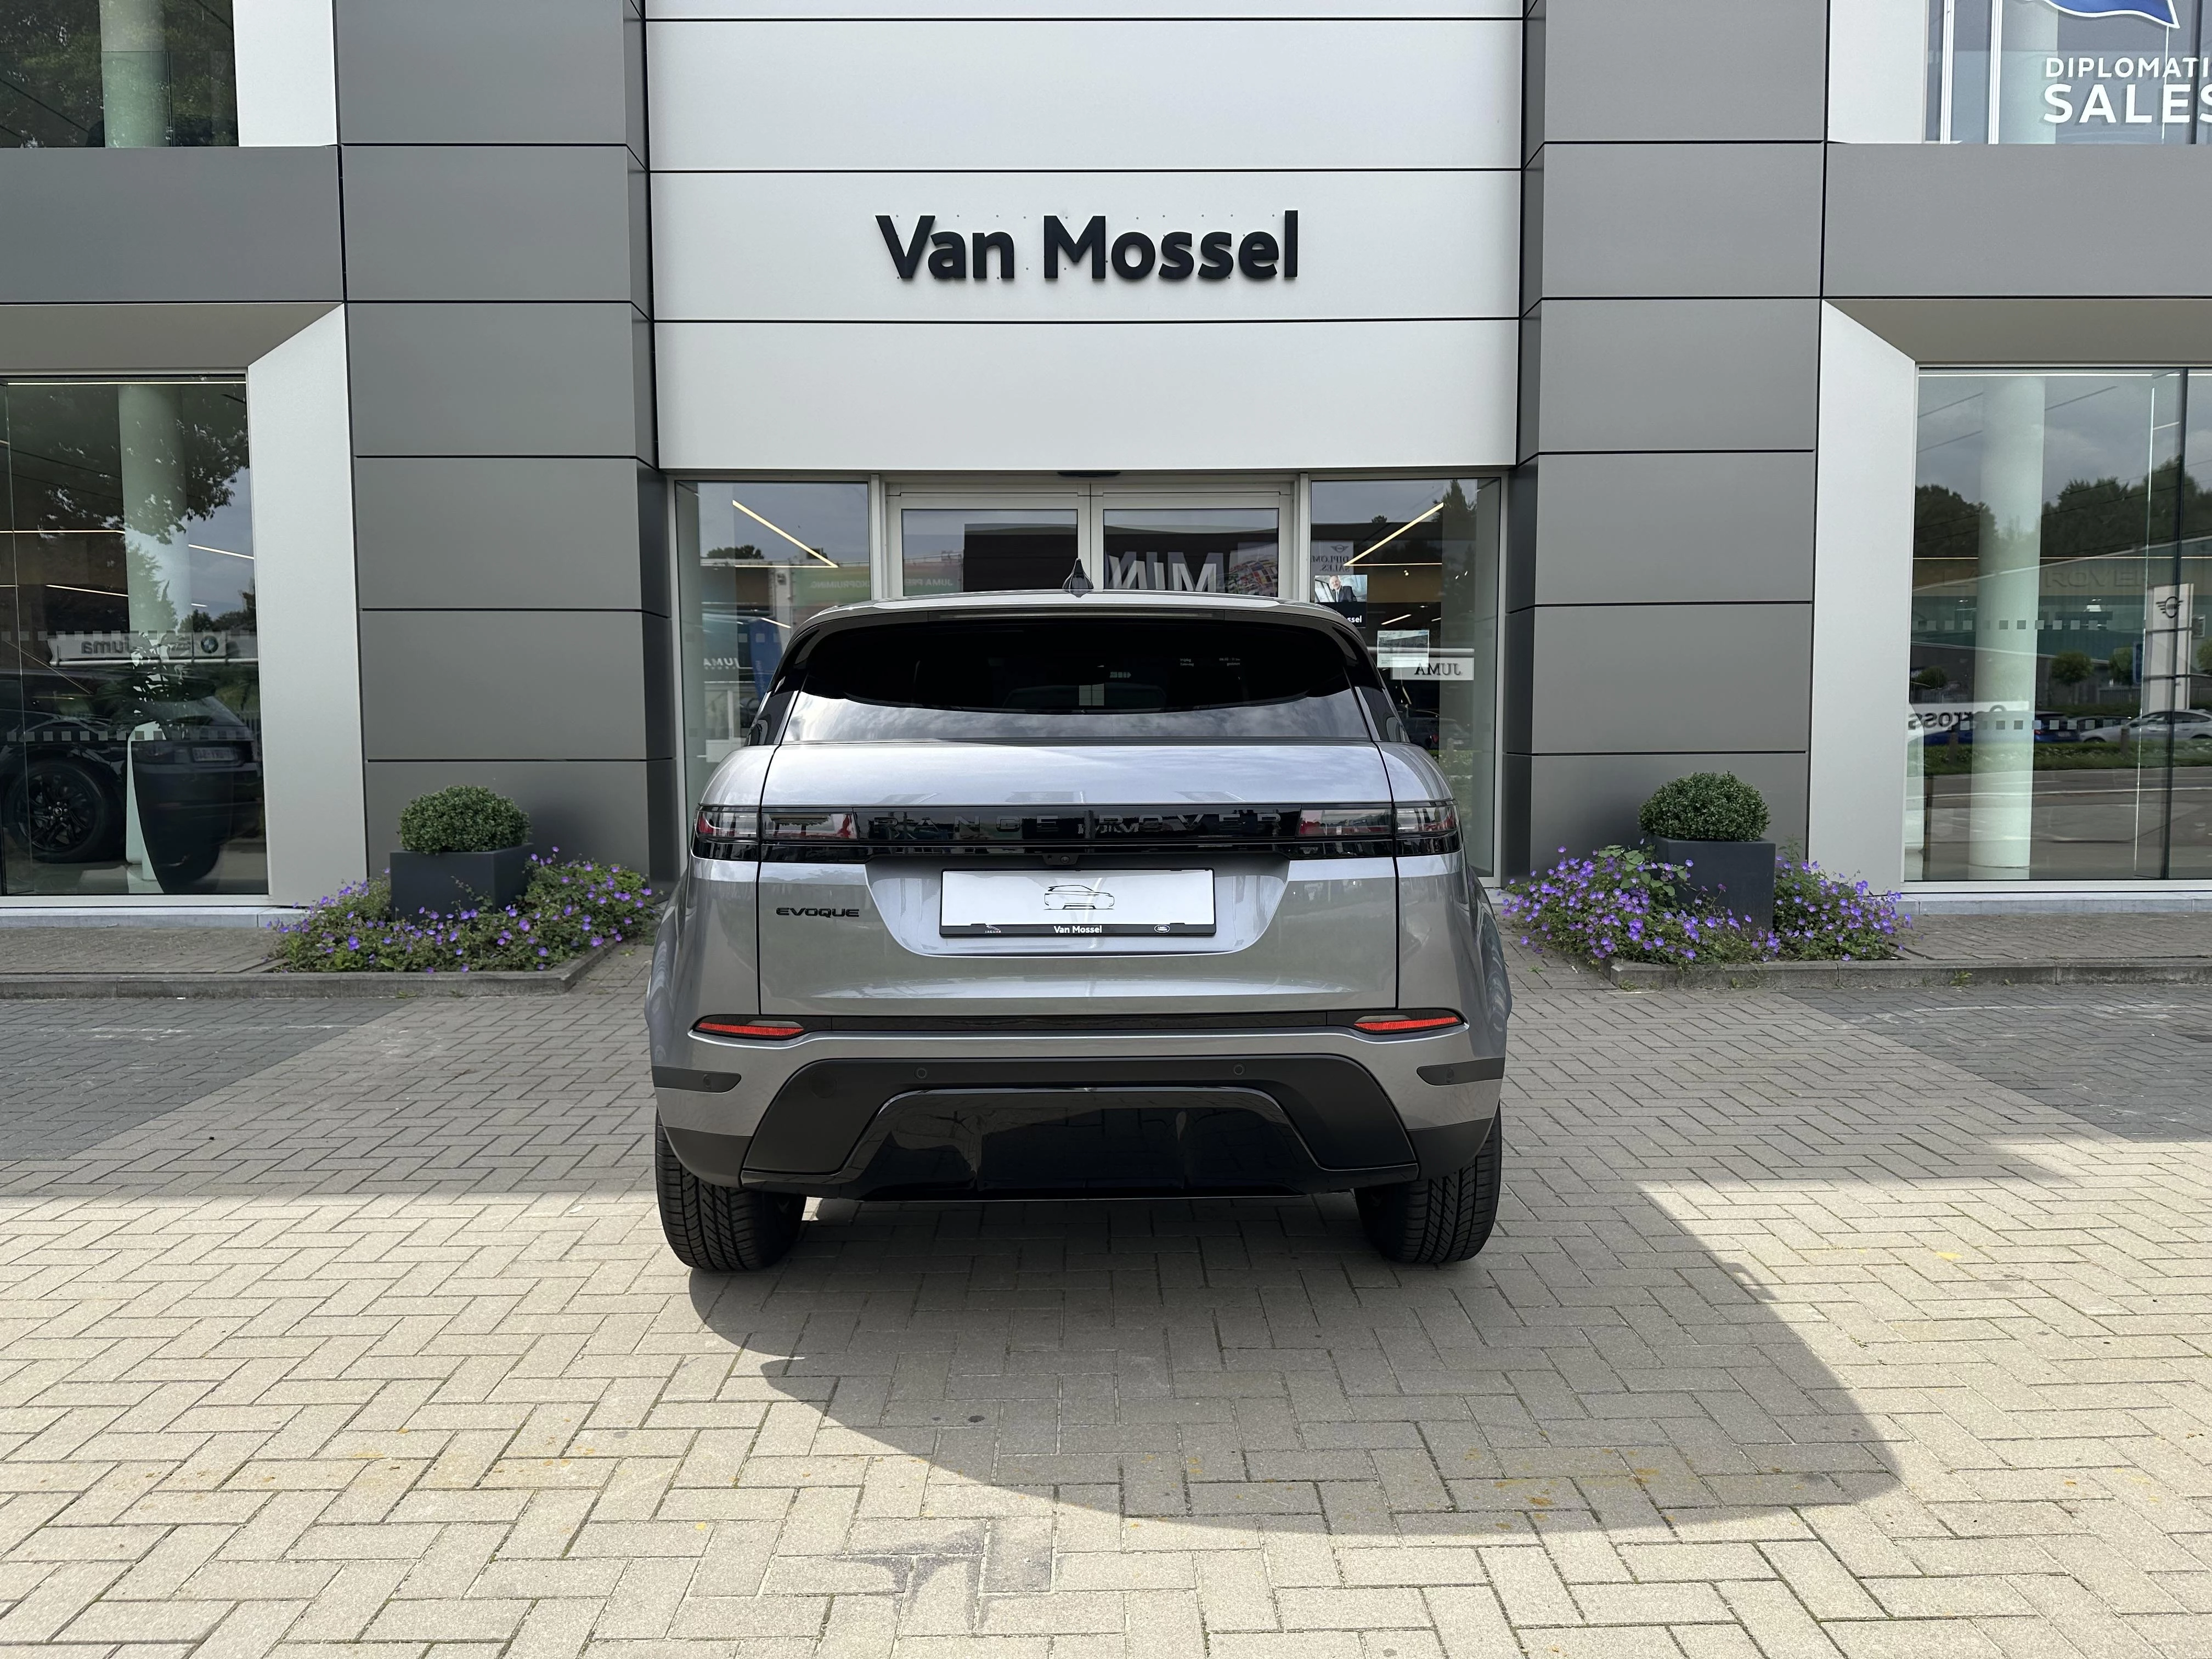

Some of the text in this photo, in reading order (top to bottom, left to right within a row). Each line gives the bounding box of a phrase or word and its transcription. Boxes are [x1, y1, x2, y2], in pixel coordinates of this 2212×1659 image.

[875, 210, 1298, 279] Van Mossel
[1347, 615, 1362, 623] ssel
[874, 814, 1282, 833] RANGE ROVER
[776, 907, 859, 918] EVOQUE
